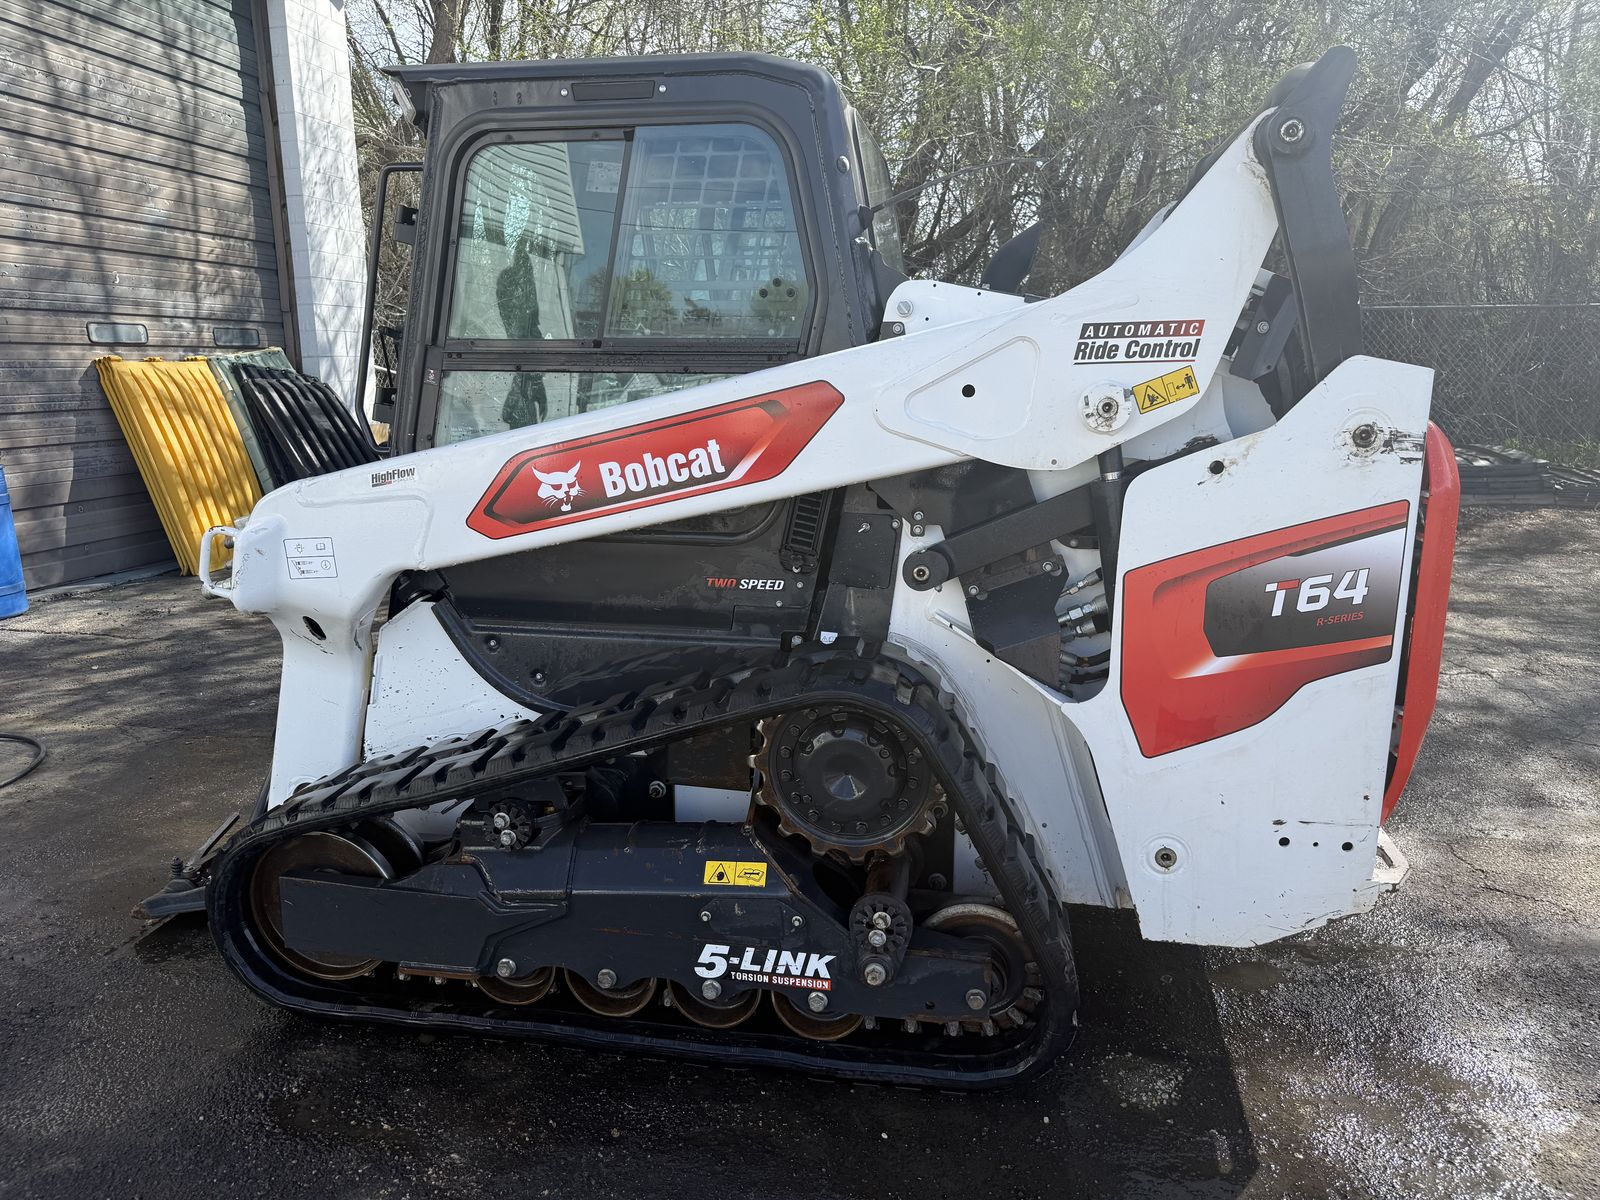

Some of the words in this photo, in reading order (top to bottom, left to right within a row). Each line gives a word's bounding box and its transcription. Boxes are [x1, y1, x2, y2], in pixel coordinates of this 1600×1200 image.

[1084, 322, 1200, 338] AUTOMATIC
[1073, 340, 1120, 361] Ride
[1124, 338, 1201, 359] Control
[371, 467, 416, 484] HighFlow
[598, 438, 726, 498] Bobcat
[706, 577, 737, 588] TWO
[739, 578, 785, 591] SPEED
[1265, 568, 1370, 617] T64
[1316, 611, 1364, 627] R-SERIES
[694, 943, 837, 979] 5-LINK
[730, 971, 769, 983] TORSION
[771, 975, 829, 989] SUSPENSION
